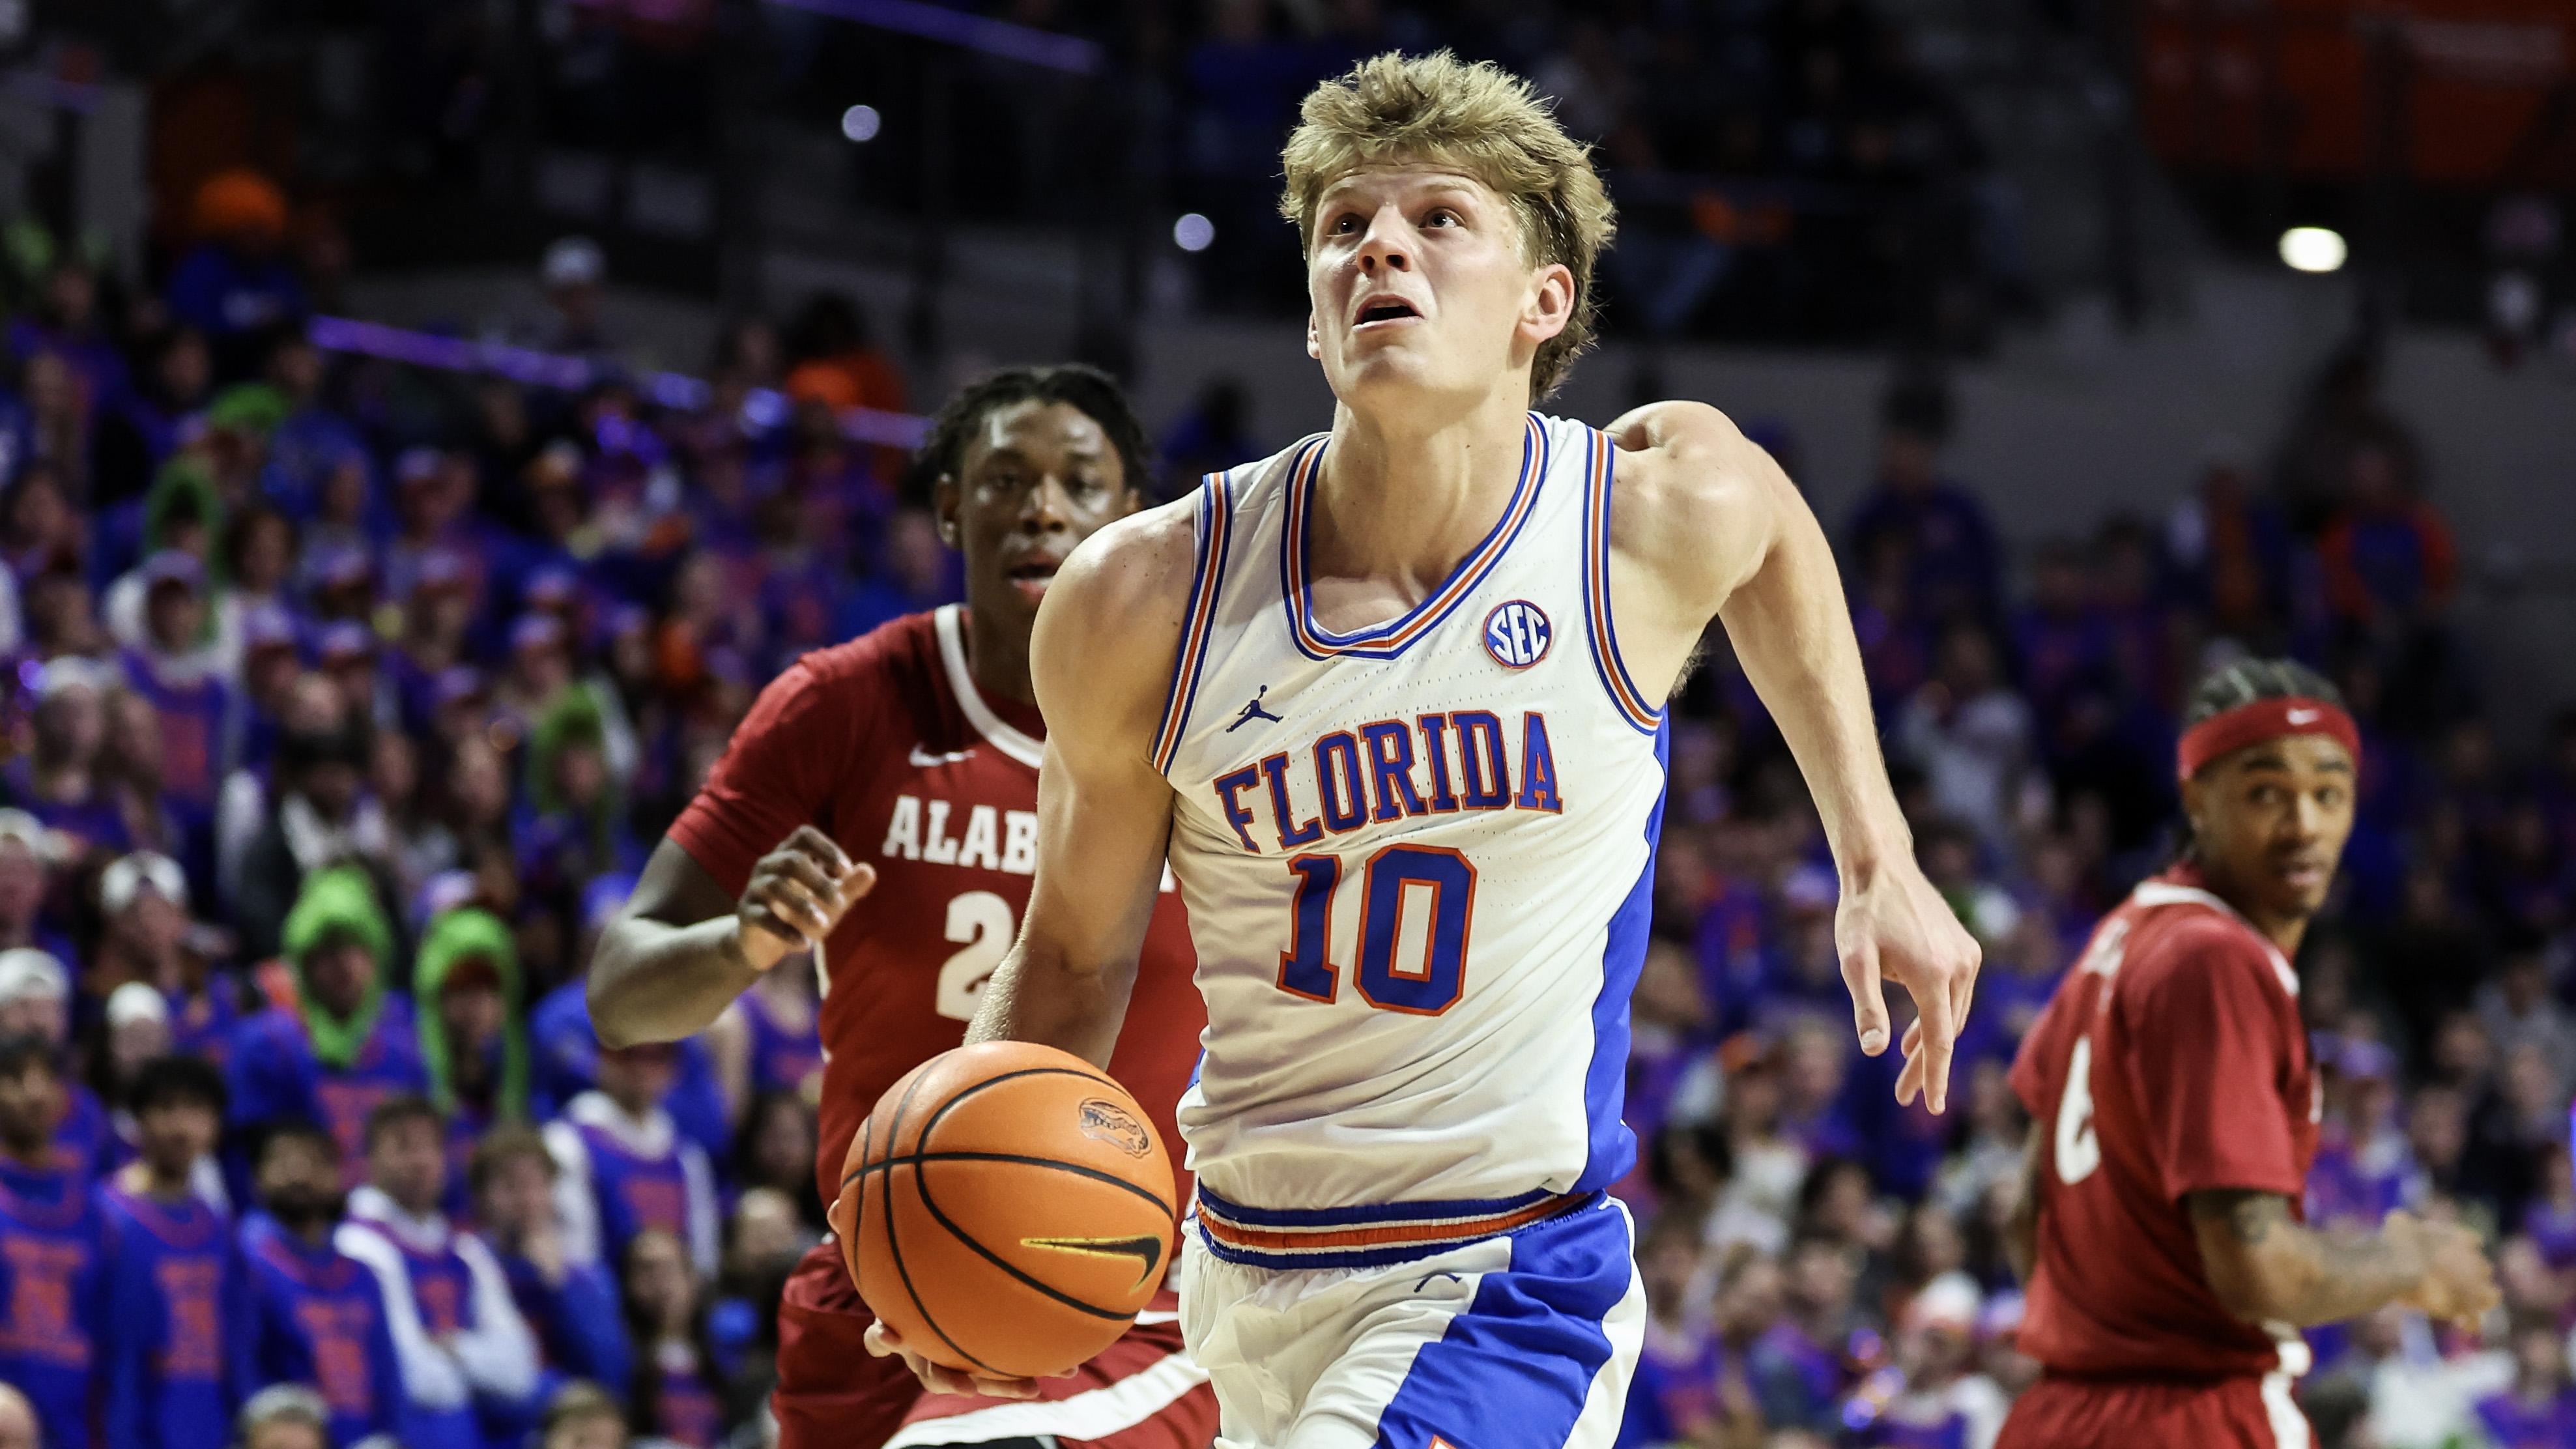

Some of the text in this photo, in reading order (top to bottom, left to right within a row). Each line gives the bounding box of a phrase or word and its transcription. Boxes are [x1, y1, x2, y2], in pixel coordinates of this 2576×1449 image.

[1488, 604, 1547, 664] SEC
[882, 794, 1038, 875] ALAB
[1214, 710, 1563, 854] FLORIDA
[1276, 842, 1478, 1016] 10
